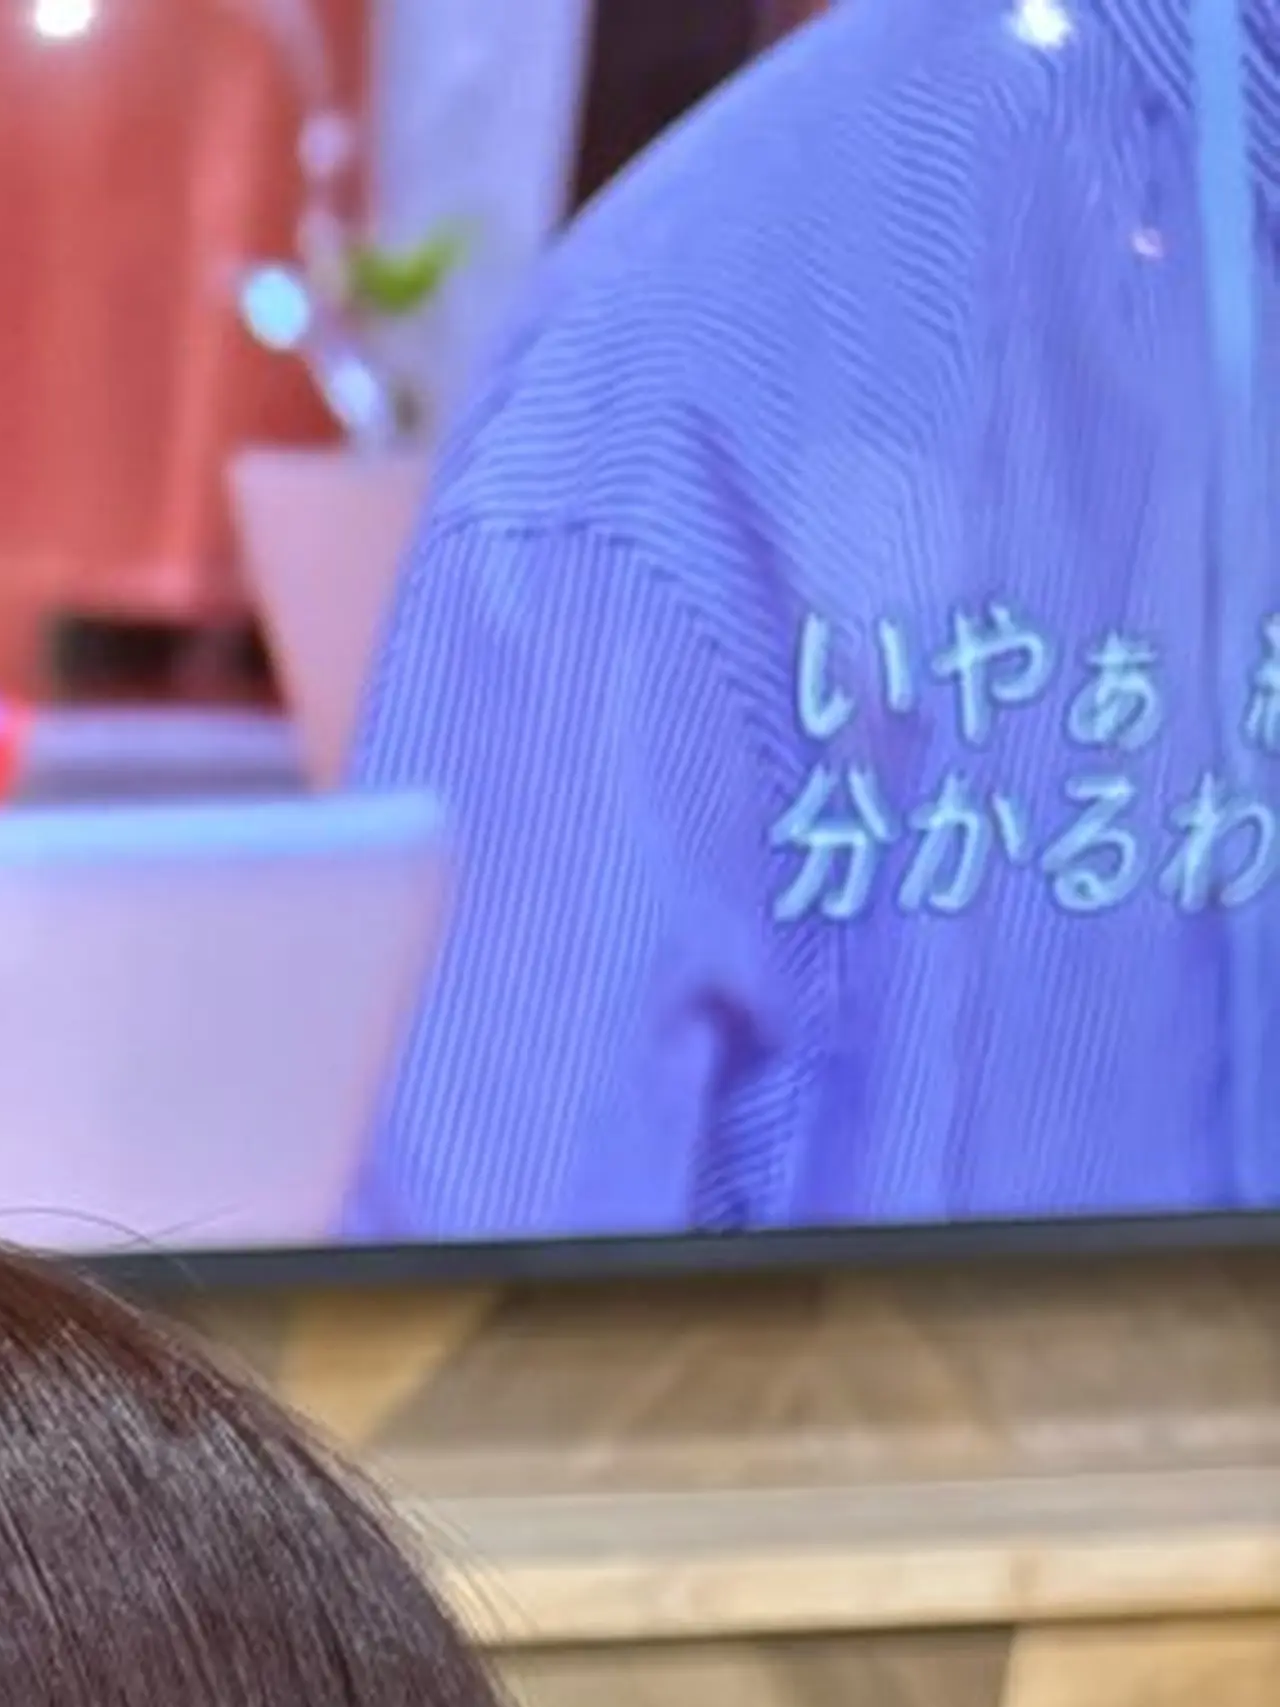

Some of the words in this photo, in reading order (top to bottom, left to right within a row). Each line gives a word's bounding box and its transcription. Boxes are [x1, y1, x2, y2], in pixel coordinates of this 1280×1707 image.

[797, 604, 1162, 747] いやぁ
[770, 766, 1277, 920] 分かるわ
